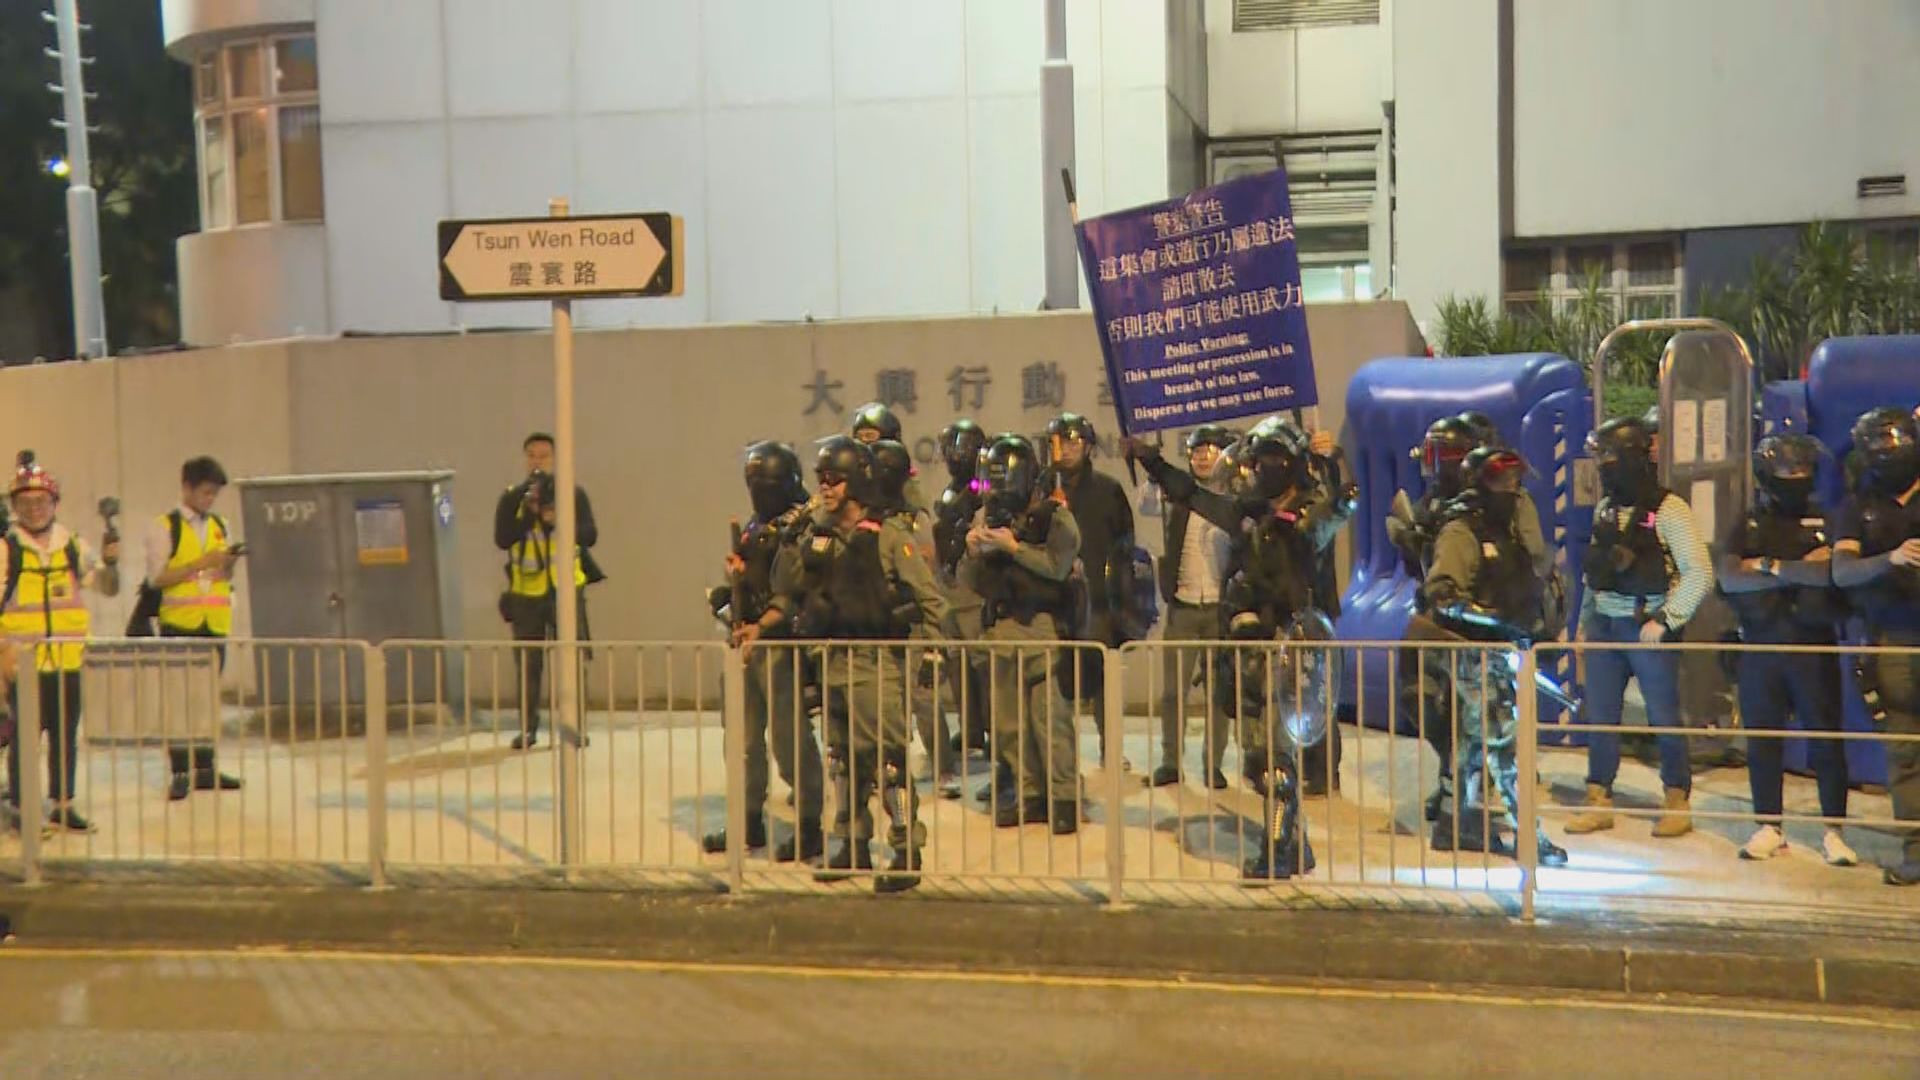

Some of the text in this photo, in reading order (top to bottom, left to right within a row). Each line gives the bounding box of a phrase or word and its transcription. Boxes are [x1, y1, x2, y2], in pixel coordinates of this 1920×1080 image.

[1153, 199, 1224, 237] 警察警告
[472, 227, 635, 250] Tsun Wen Road
[1098, 215, 1296, 281] 這集會或遊行乃屬違法
[508, 260, 597, 286] 震寰路
[1161, 262, 1236, 301] 請即散去
[1106, 282, 1302, 342] 否則我們可能使用武力
[1125, 342, 1294, 384] This meeting or procession is in
[1164, 342, 1199, 358] Police
[1164, 370, 1261, 395] breach of the law.
[1134, 385, 1295, 420] Disperse or we may use force.
